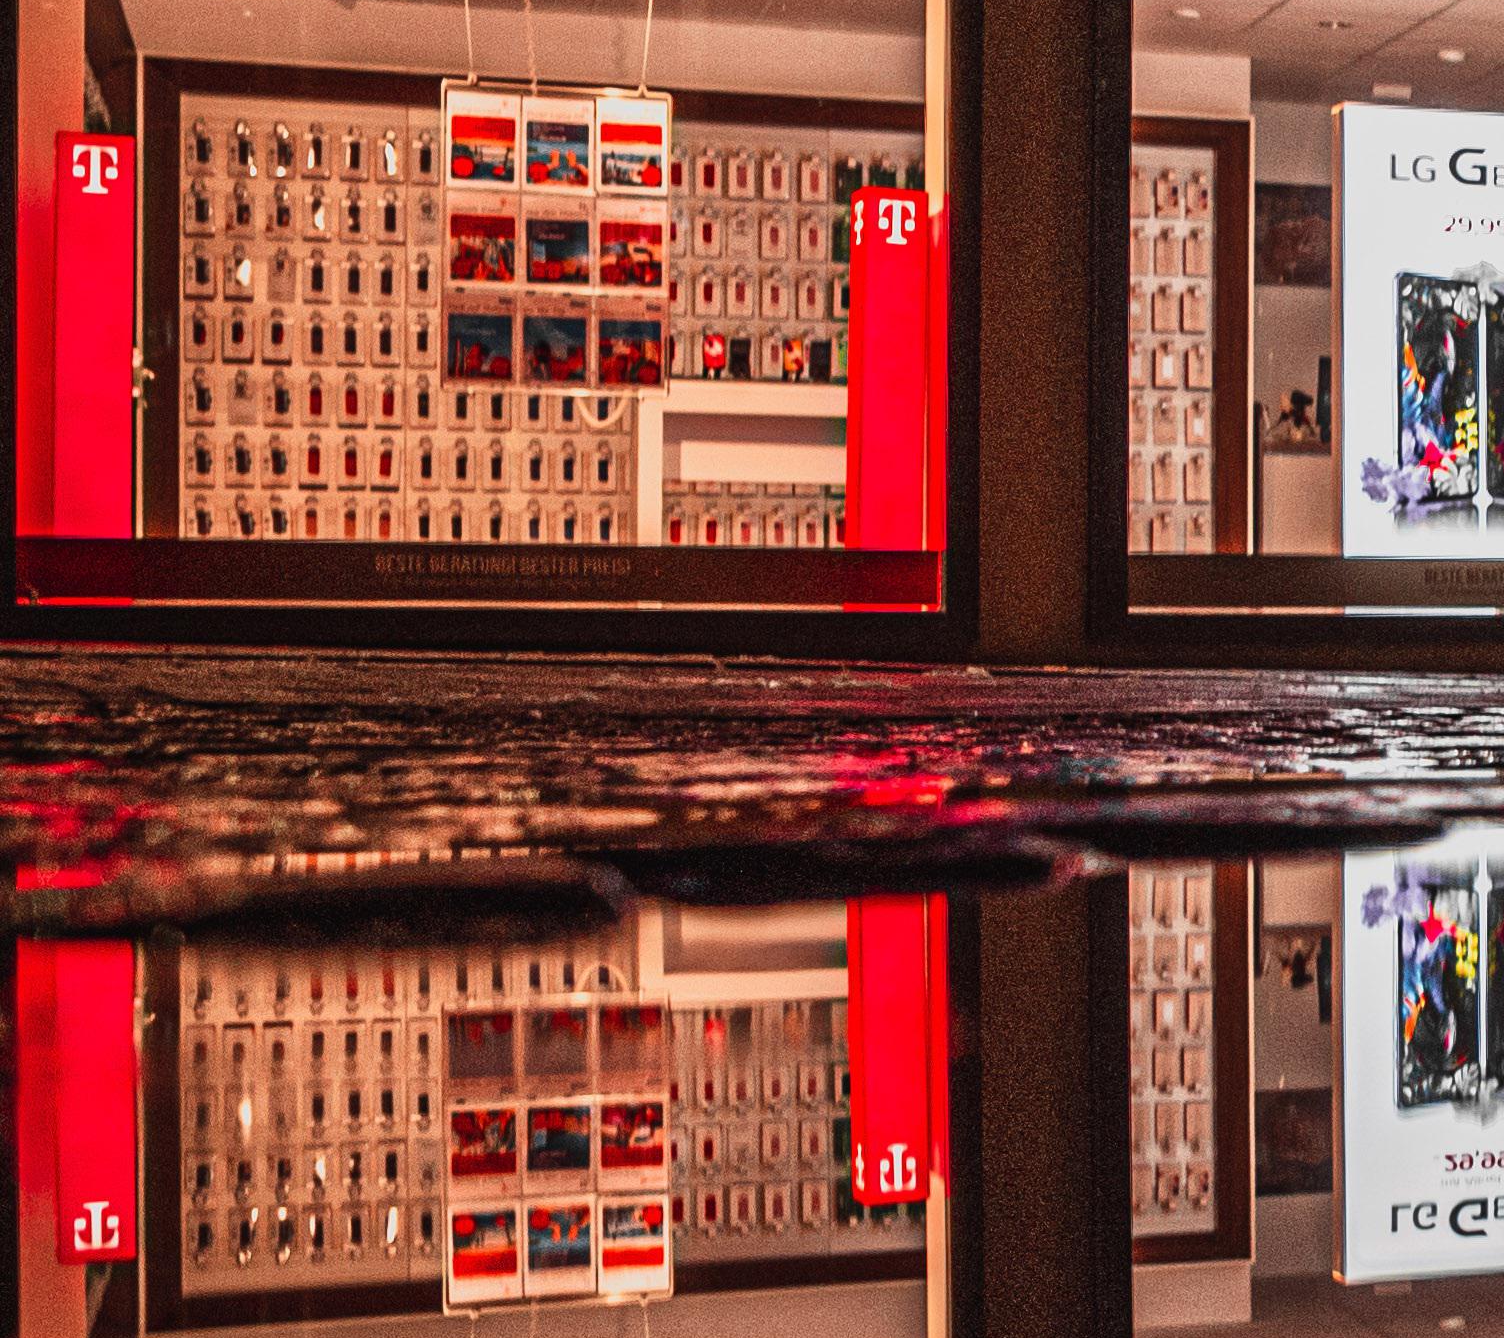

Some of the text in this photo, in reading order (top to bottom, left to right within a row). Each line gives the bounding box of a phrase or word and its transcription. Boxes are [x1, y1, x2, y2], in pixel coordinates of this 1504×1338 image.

[72, 143, 119, 194] T
[1389, 152, 1438, 184] LG
[878, 198, 916, 245] T
